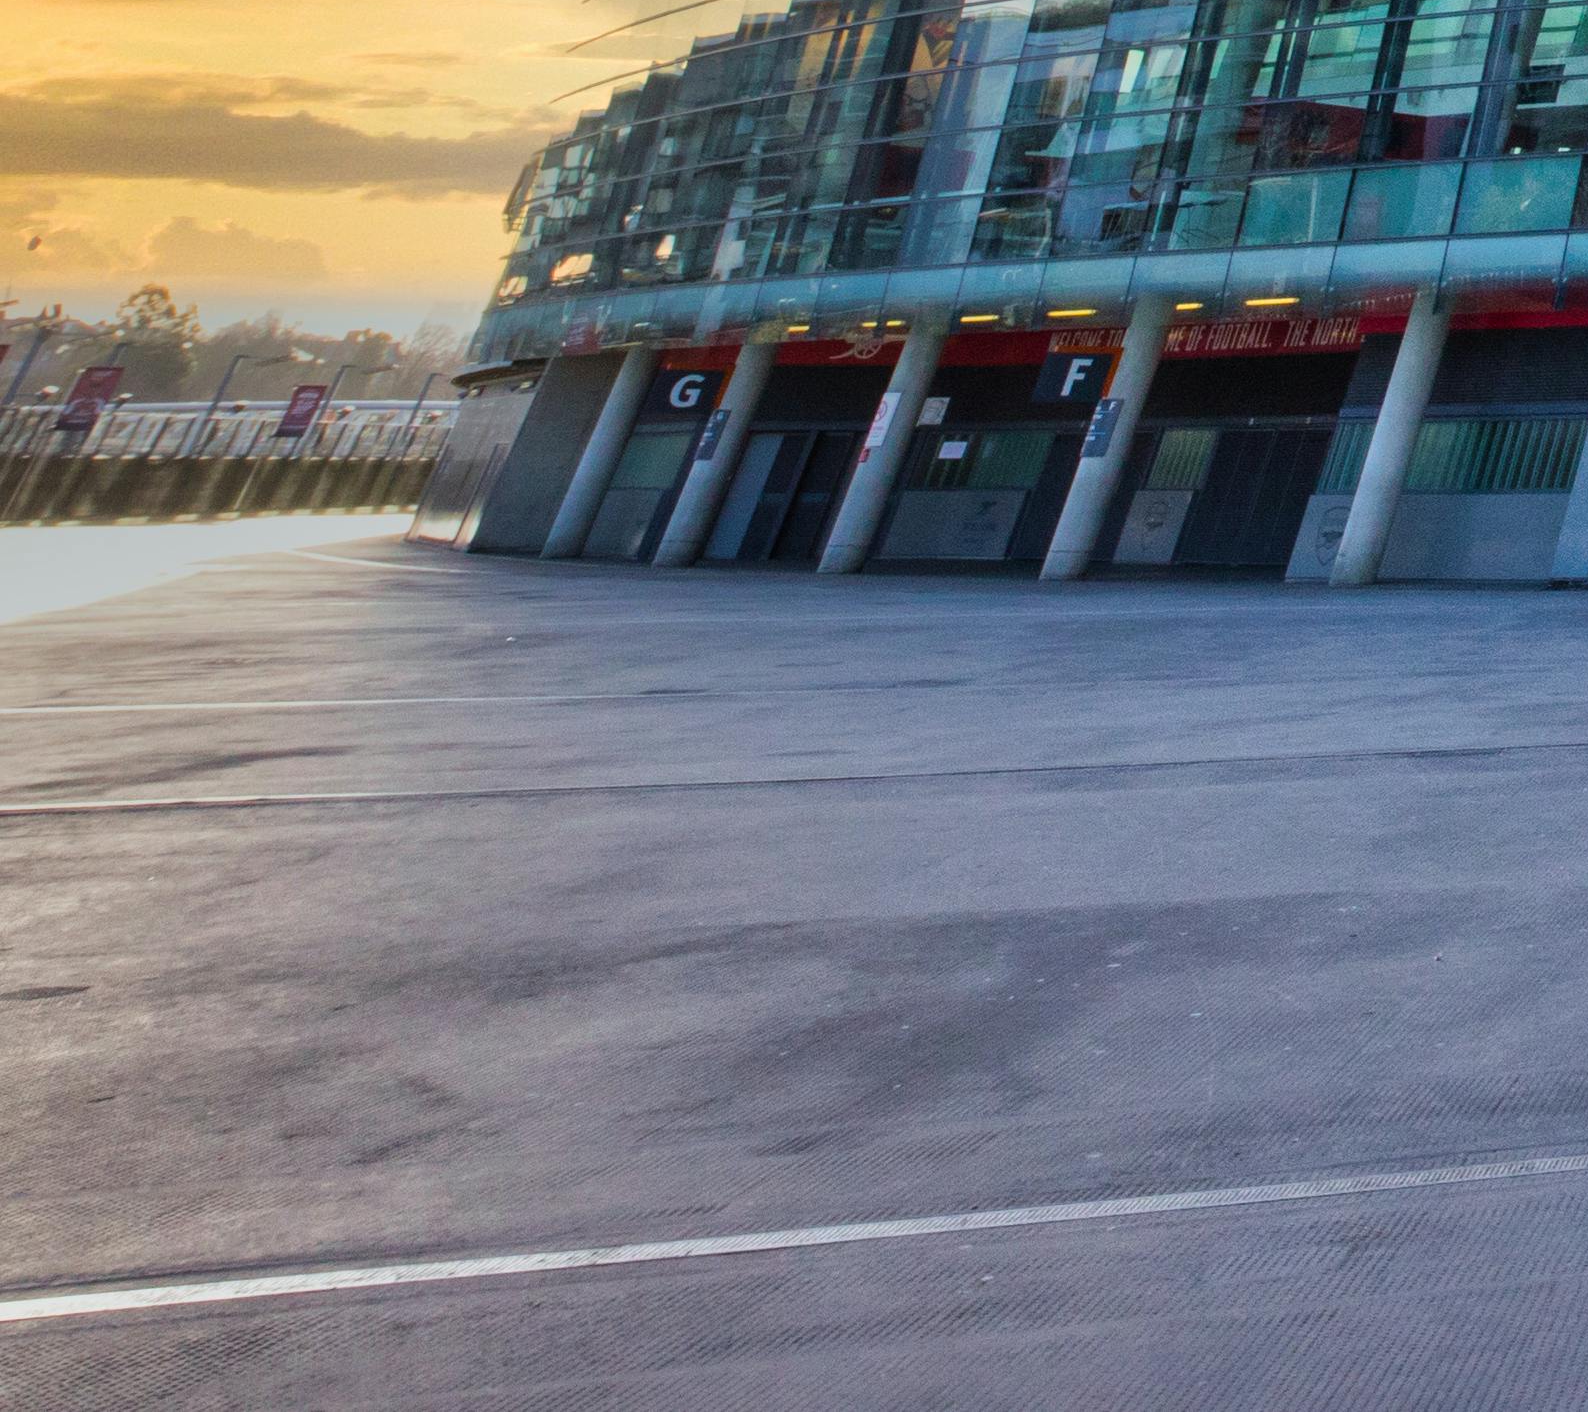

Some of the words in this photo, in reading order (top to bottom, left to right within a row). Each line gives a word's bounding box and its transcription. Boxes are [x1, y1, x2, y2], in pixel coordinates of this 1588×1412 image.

[1185, 326, 1206, 351] OF
[1284, 319, 1311, 347] THE
[669, 374, 705, 408] G
[1060, 358, 1094, 396] F
